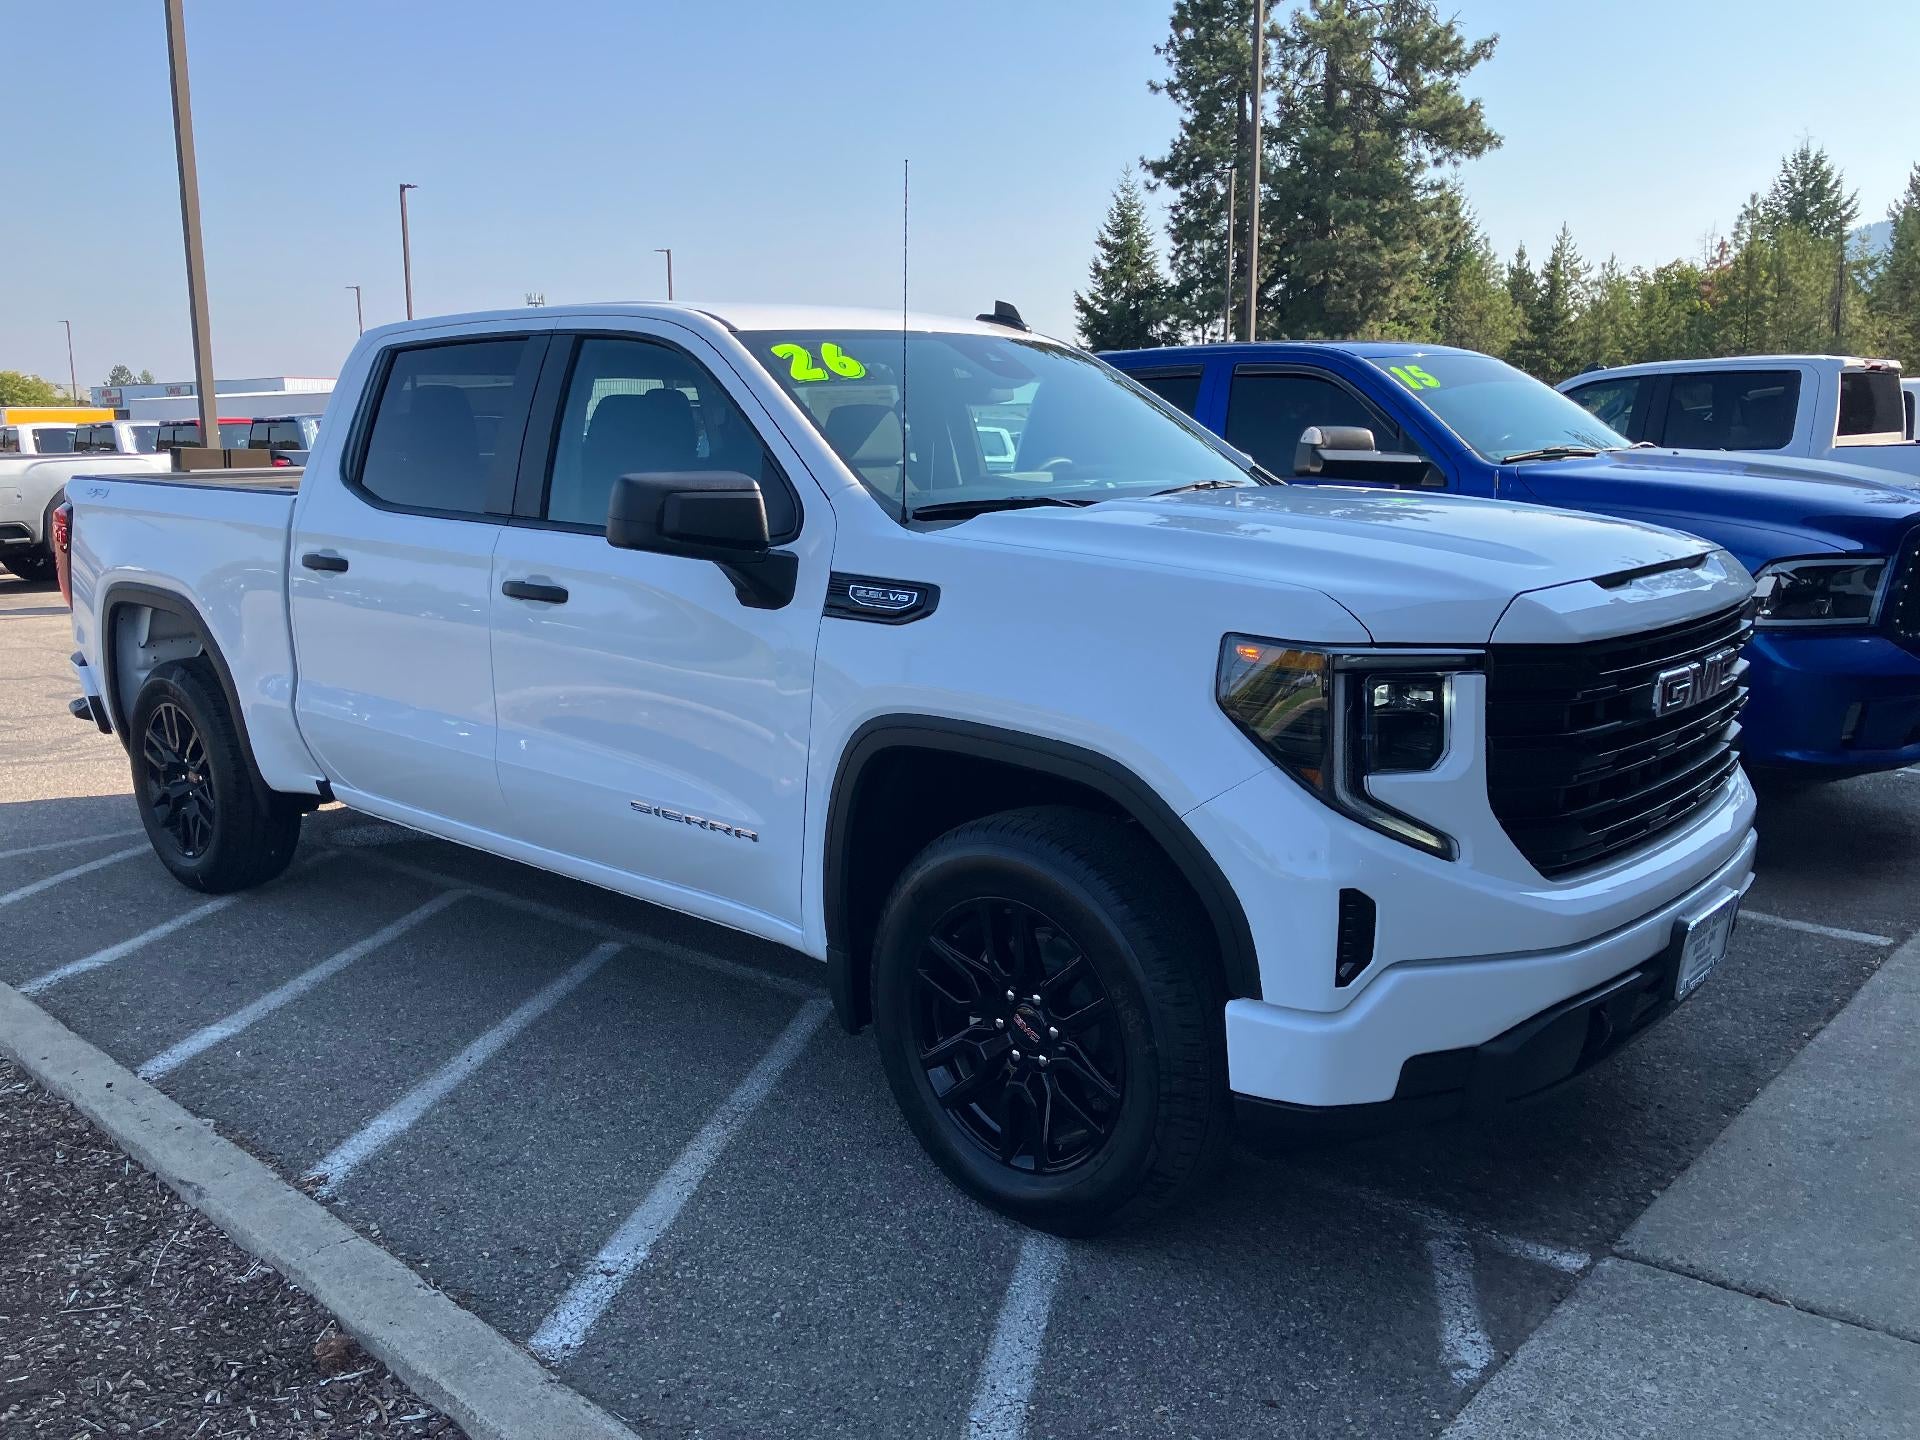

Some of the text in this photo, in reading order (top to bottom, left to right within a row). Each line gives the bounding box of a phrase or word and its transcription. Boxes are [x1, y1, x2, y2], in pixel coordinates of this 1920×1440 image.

[770, 342, 867, 384] 26
[1389, 365, 1441, 391] 15
[1654, 647, 1738, 718] GMC
[630, 799, 760, 843] SIERRA
